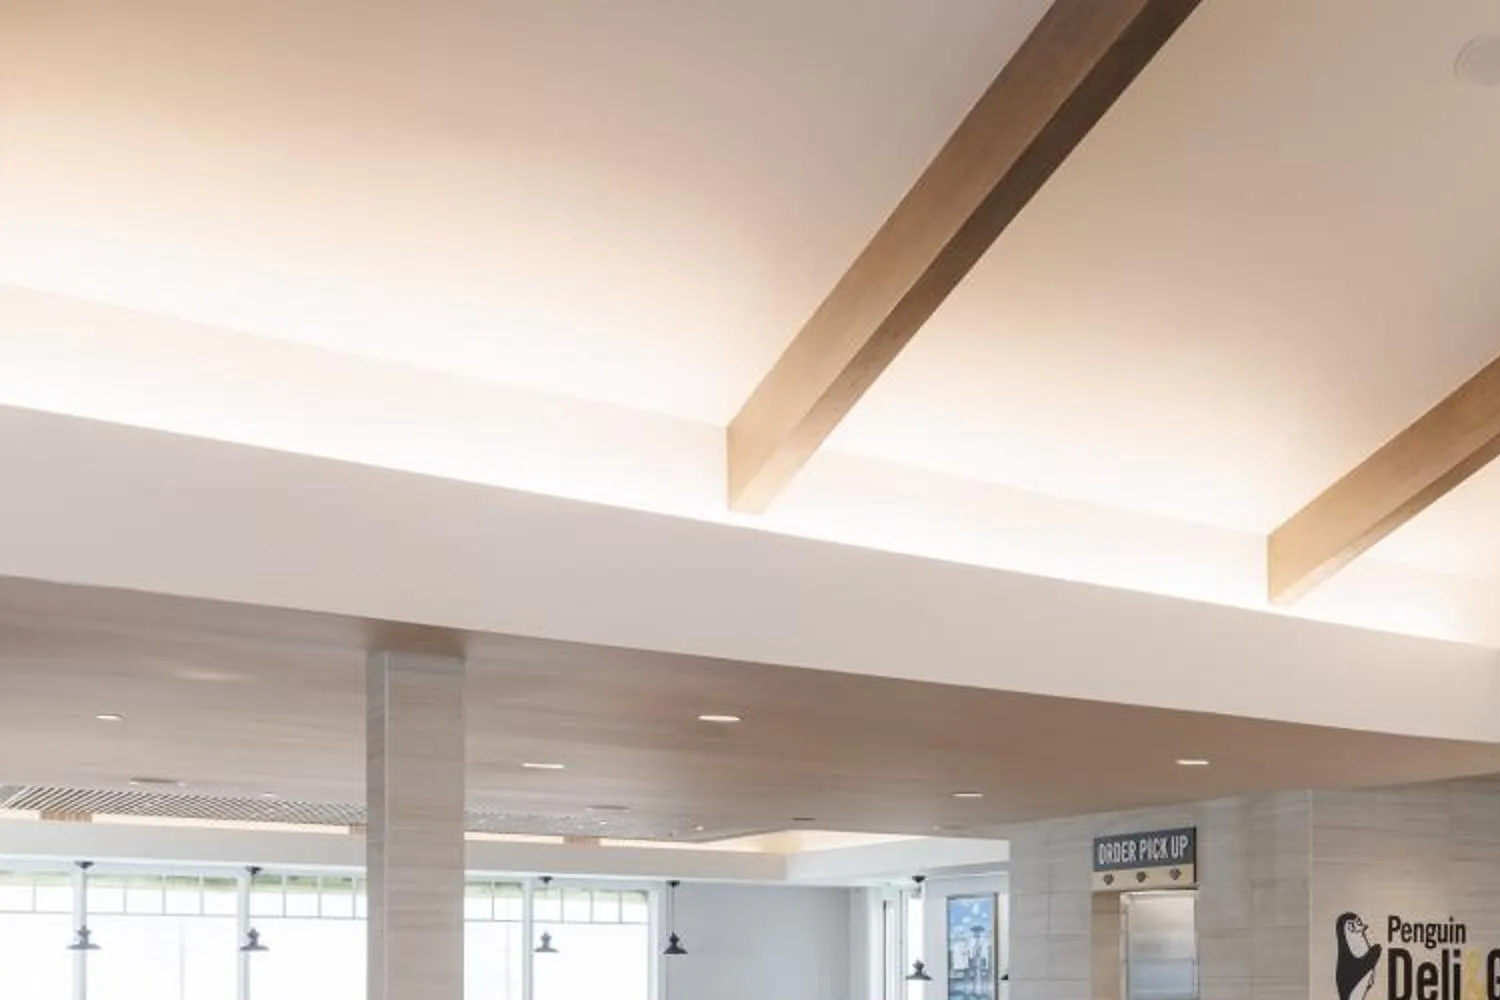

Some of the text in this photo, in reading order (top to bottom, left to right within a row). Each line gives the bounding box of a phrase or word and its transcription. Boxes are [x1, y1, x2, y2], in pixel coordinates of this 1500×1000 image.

[1098, 835, 1189, 864] ORDER PICK UP
[1387, 915, 1467, 949] Penguin
